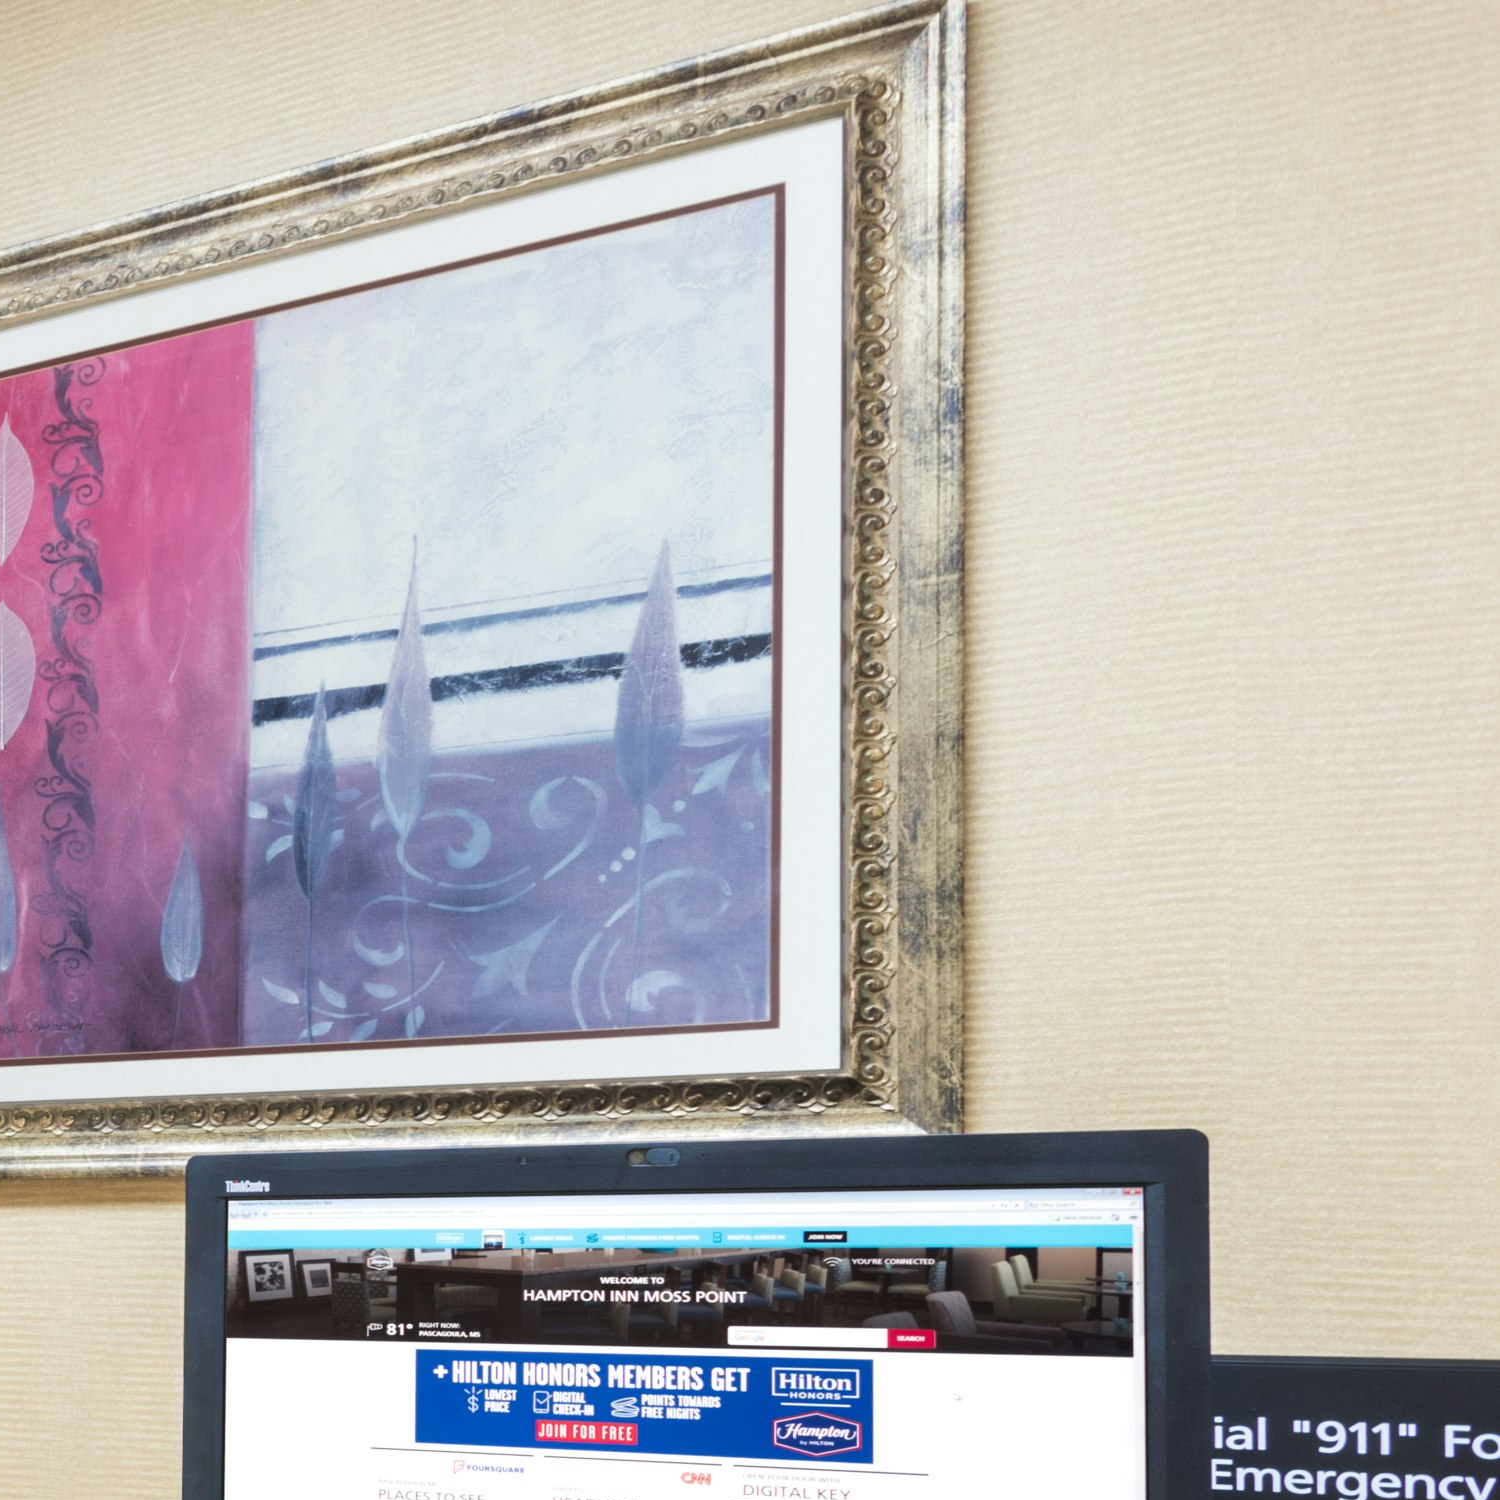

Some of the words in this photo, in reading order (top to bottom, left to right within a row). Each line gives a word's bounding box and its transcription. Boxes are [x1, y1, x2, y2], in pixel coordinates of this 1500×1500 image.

[600, 1277, 648, 1285] WELCOME
[651, 1277, 664, 1285] TO
[523, 1289, 605, 1302] HAMPTON
[610, 1290, 639, 1303] INN
[644, 1291, 691, 1303] MOSS
[696, 1291, 747, 1304] POINT
[452, 1360, 516, 1385] HILTON
[523, 1363, 600, 1387] HONORS
[608, 1365, 703, 1391] MEMBERS
[711, 1367, 750, 1392] GET
[779, 1373, 852, 1391] Hilton
[485, 1389, 517, 1401] LOWEST
[553, 1391, 585, 1403] DIGITAL
[641, 1394, 674, 1407] POINTS
[678, 1396, 721, 1408] TOWARDS
[789, 1392, 841, 1400] HONORS
[485, 1401, 510, 1413] PRICE
[553, 1404, 594, 1416] CHECK-IN
[641, 1408, 663, 1419] FREE
[666, 1408, 700, 1420] NIGHTS
[538, 1423, 567, 1438] JOIN
[573, 1425, 596, 1439] FOR
[602, 1426, 633, 1441] FREE
[777, 1422, 857, 1441] Hampton
[1213, 1417, 1267, 1451] ial
[1293, 1420, 1417, 1455] "911"
[1445, 1424, 1500, 1458] Fo
[467, 1464, 525, 1473] FOURSQUARE
[680, 1472, 711, 1485] CNN
[743, 1485, 811, 1499] DIGITAL
[818, 1489, 851, 1500] KEY
